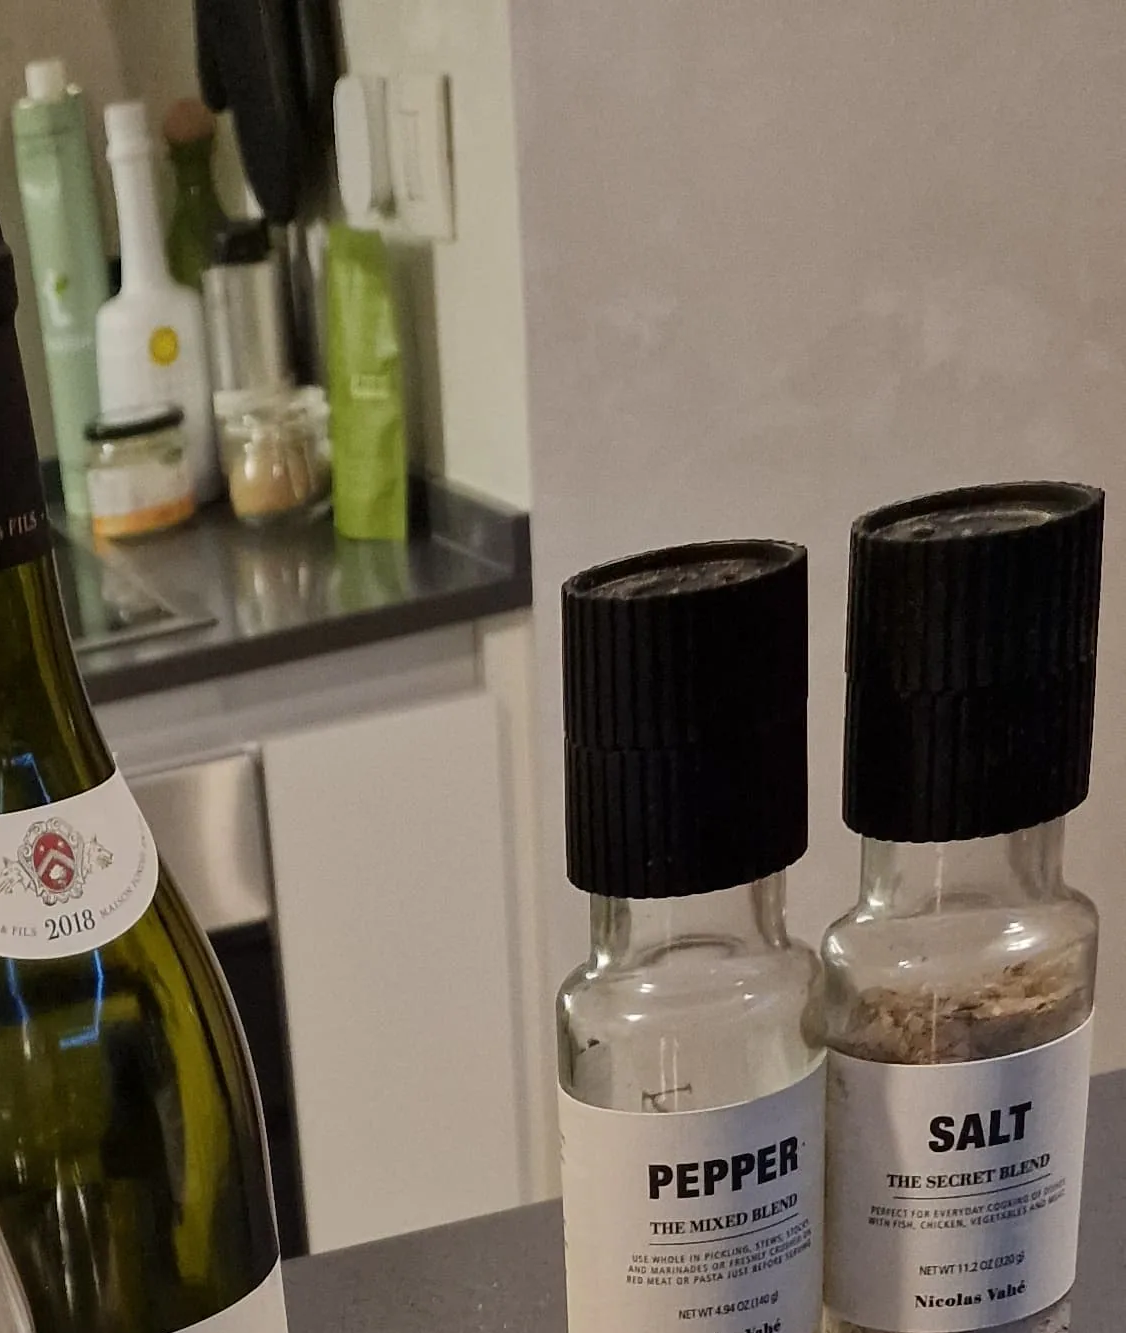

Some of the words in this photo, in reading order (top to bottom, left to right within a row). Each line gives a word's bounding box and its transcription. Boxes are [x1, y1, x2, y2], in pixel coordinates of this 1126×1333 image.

[9, 510, 37, 537] FILS
[11, 926, 37, 937] FILS
[44, 908, 97, 940] 2018
[928, 1101, 1032, 1153] SALT
[648, 1136, 798, 1200] PEPPER
[886, 1173, 922, 1188] THE
[925, 1168, 996, 1189] SECRET
[999, 1153, 1051, 1180] BLEND
[650, 1221, 686, 1236] THE
[689, 1212, 748, 1234] MIXED
[752, 1193, 798, 1222] BLEND
[911, 1208, 930, 1219] FOR
[921, 1219, 966, 1230] CHICKEN,
[626, 1275, 643, 1285] RED
[647, 1276, 672, 1286] MEAT
[676, 1276, 690, 1285] OR
[693, 1272, 723, 1284] PASTA
[727, 1268, 749, 1280] JUST
[752, 1257, 783, 1274] BEFORE
[628, 1265, 647, 1274] AND
[650, 1264, 708, 1275] MARINADES
[632, 1254, 649, 1264] USE
[652, 1254, 685, 1264] WHOLE
[690, 1254, 700, 1263] IN
[919, 1265, 938, 1276] NET
[938, 1263, 955, 1275] WT
[979, 1258, 993, 1270] OZ
[915, 1292, 982, 1308] Nicolas
[987, 1280, 1026, 1301] Vahé
[678, 1309, 696, 1320] NET
[698, 1307, 714, 1318] WT
[736, 1300, 751, 1311] OZ
